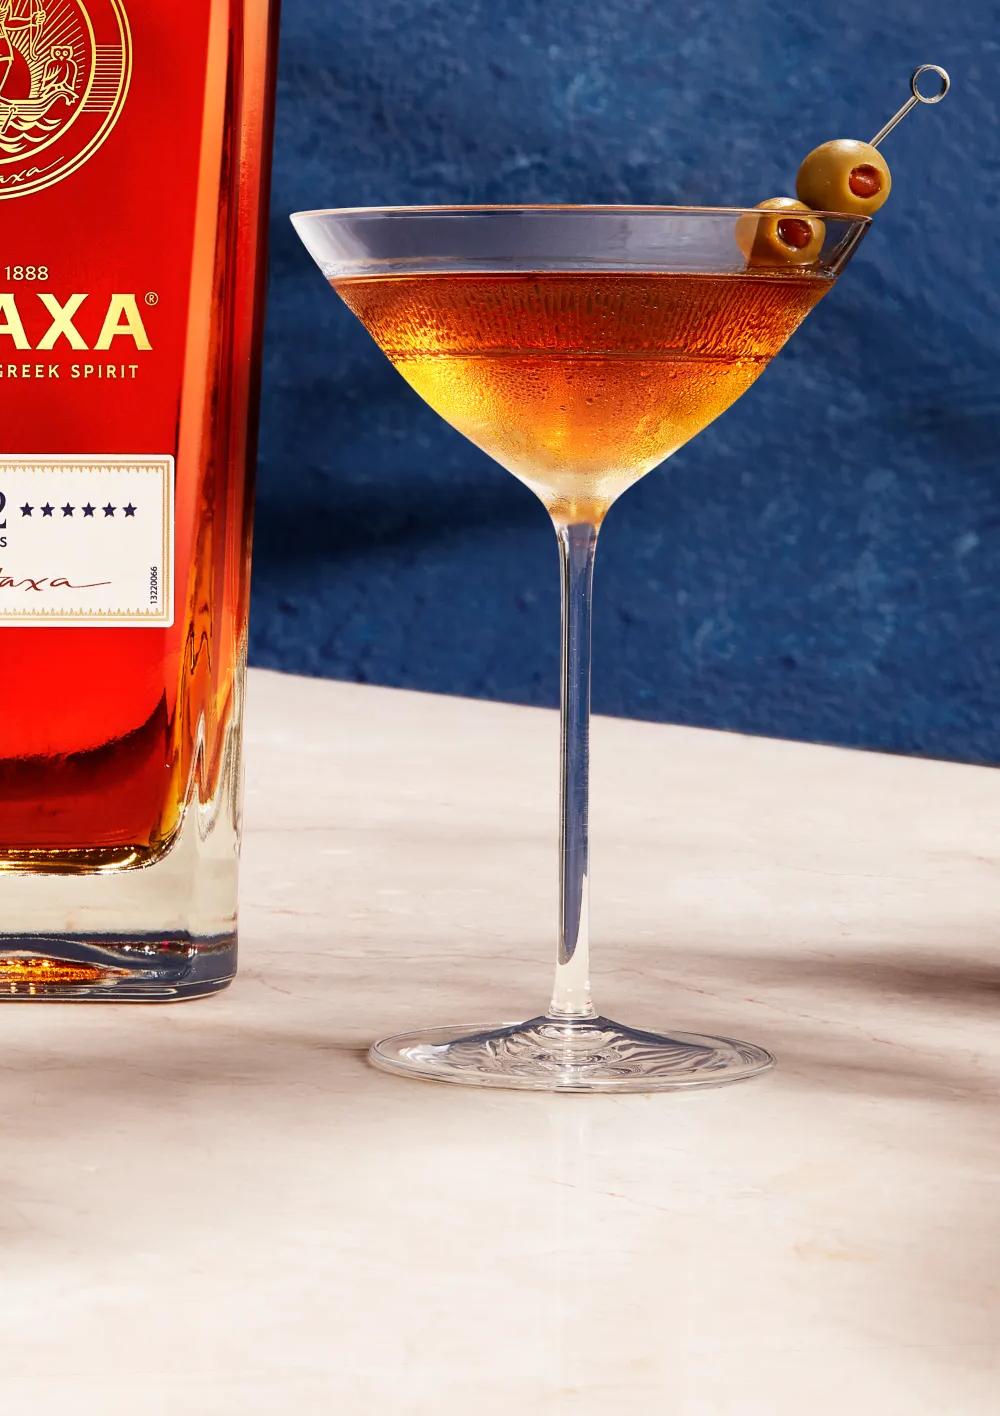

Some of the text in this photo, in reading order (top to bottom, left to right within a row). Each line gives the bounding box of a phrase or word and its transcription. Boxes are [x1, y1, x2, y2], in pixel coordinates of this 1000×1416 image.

[4, 266, 49, 280] 1888
[71, 364, 139, 379] SPIRIT
[150, 566, 158, 604] 13220066
